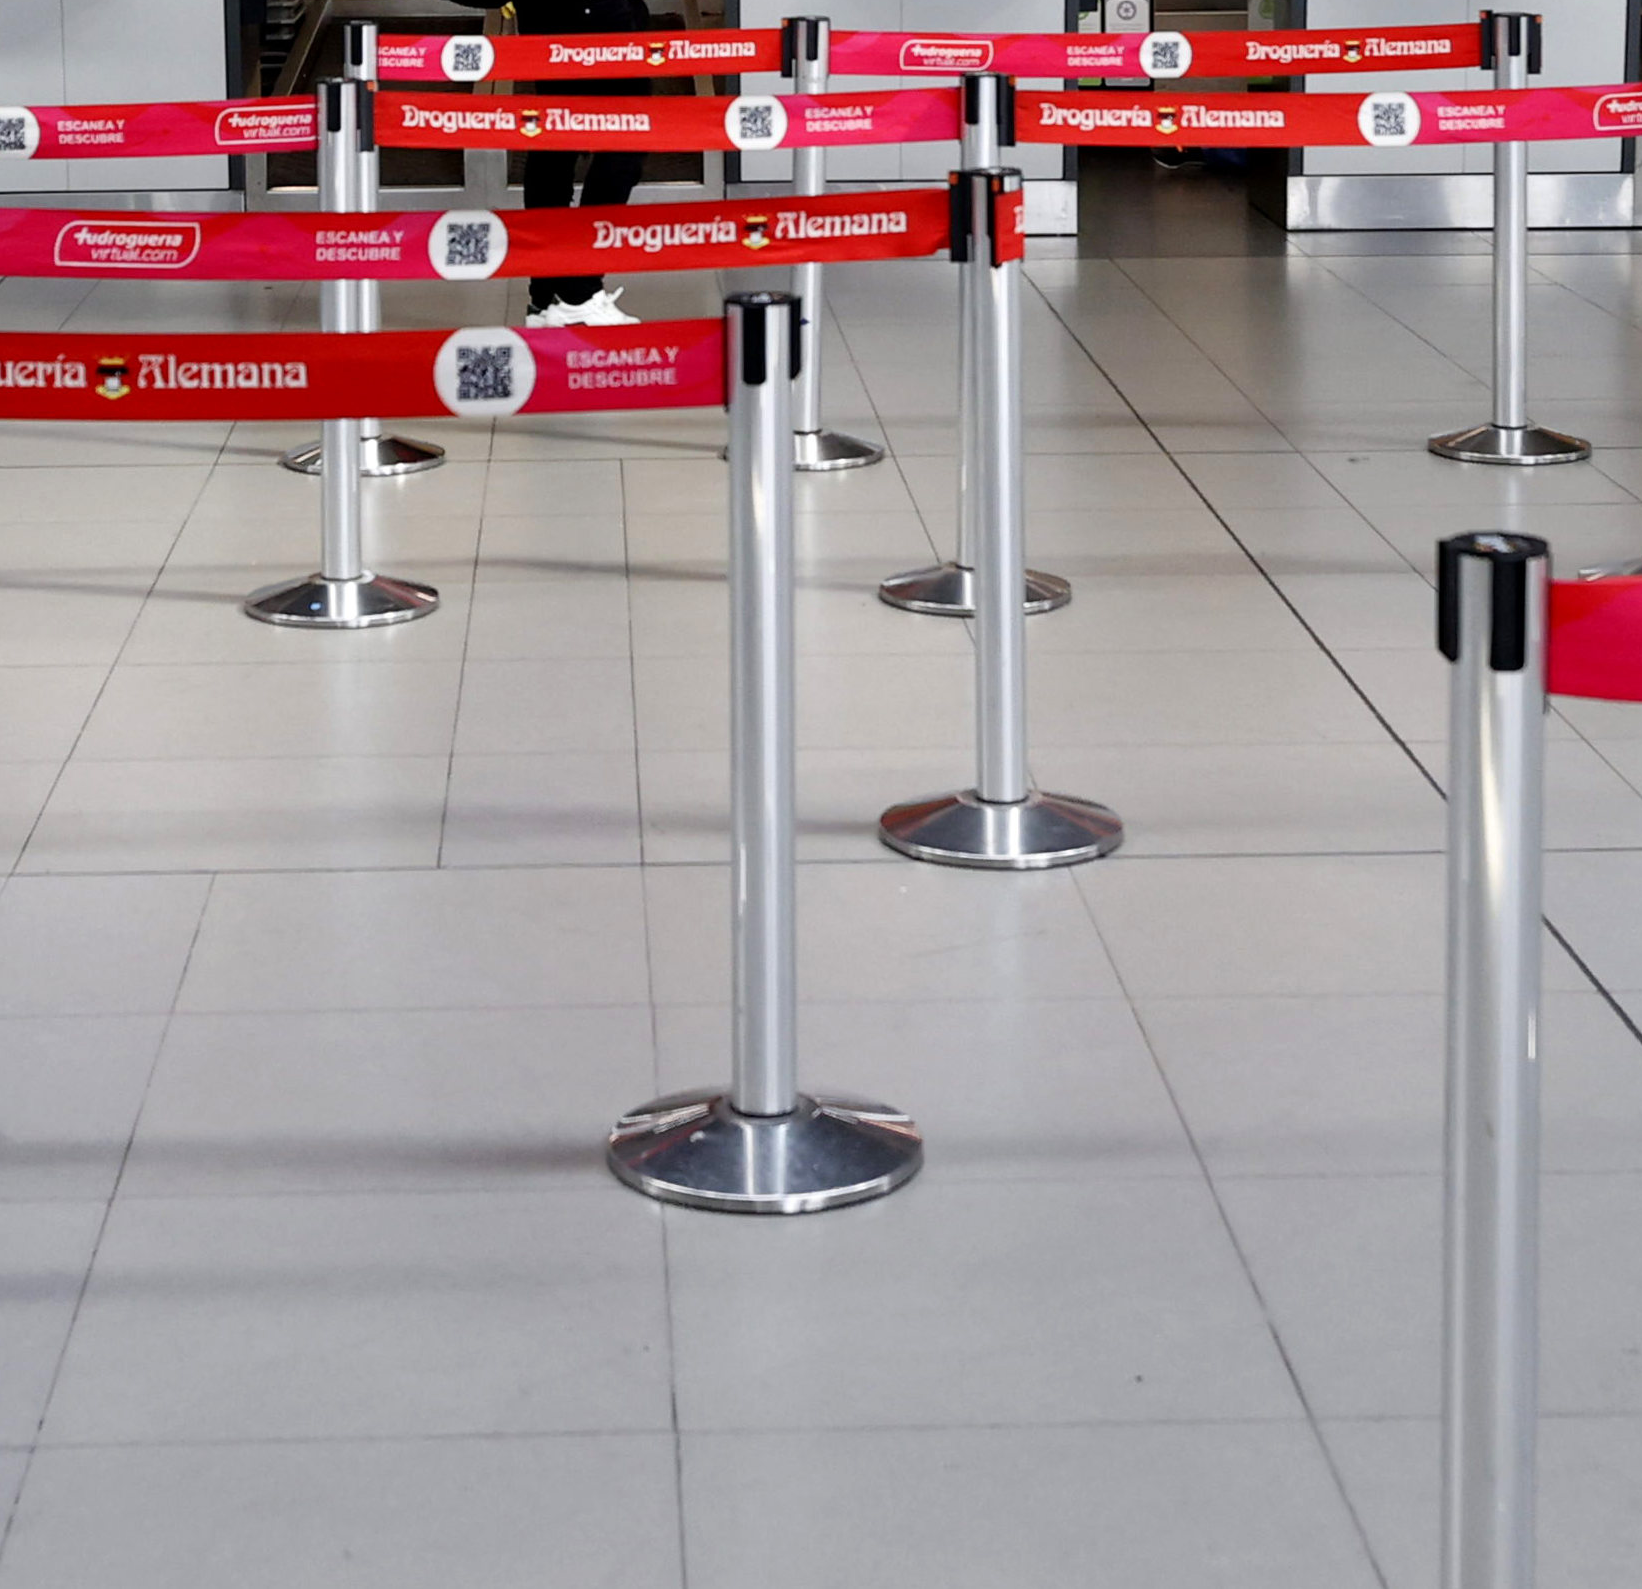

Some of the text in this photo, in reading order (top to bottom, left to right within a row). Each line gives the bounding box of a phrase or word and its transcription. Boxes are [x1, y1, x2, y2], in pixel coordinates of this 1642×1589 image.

[377, 45, 427, 57] CANEA Y
[549, 40, 756, 66] Droguería Alemana
[1066, 45, 1125, 55] ESCANEA Y
[1245, 37, 1452, 63] Droguería Alemana
[378, 56, 425, 68] SCUBRE
[1067, 56, 1124, 66] DESCUBRE
[401, 104, 651, 133] Droguería Alemana
[804, 106, 874, 120] ESCANEA Y
[1039, 102, 1285, 127] Droguería Alemana
[1437, 106, 1506, 118] ESCANEA Y
[57, 119, 126, 132] ESCANEA Y
[805, 118, 873, 132] DESCUBRE
[1438, 118, 1506, 130] DESCUBRE
[58, 131, 125, 145] DESCUBRE
[315, 230, 403, 245] ESCANEA Y
[592, 211, 908, 252] Droguería Alemana
[90, 245, 178, 263] virtual.com
[315, 246, 401, 262] DESCUBRE
[566, 346, 679, 368] ESCANEA Y
[136, 353, 309, 390] Alemana
[567, 368, 678, 390] DESCUBRE
